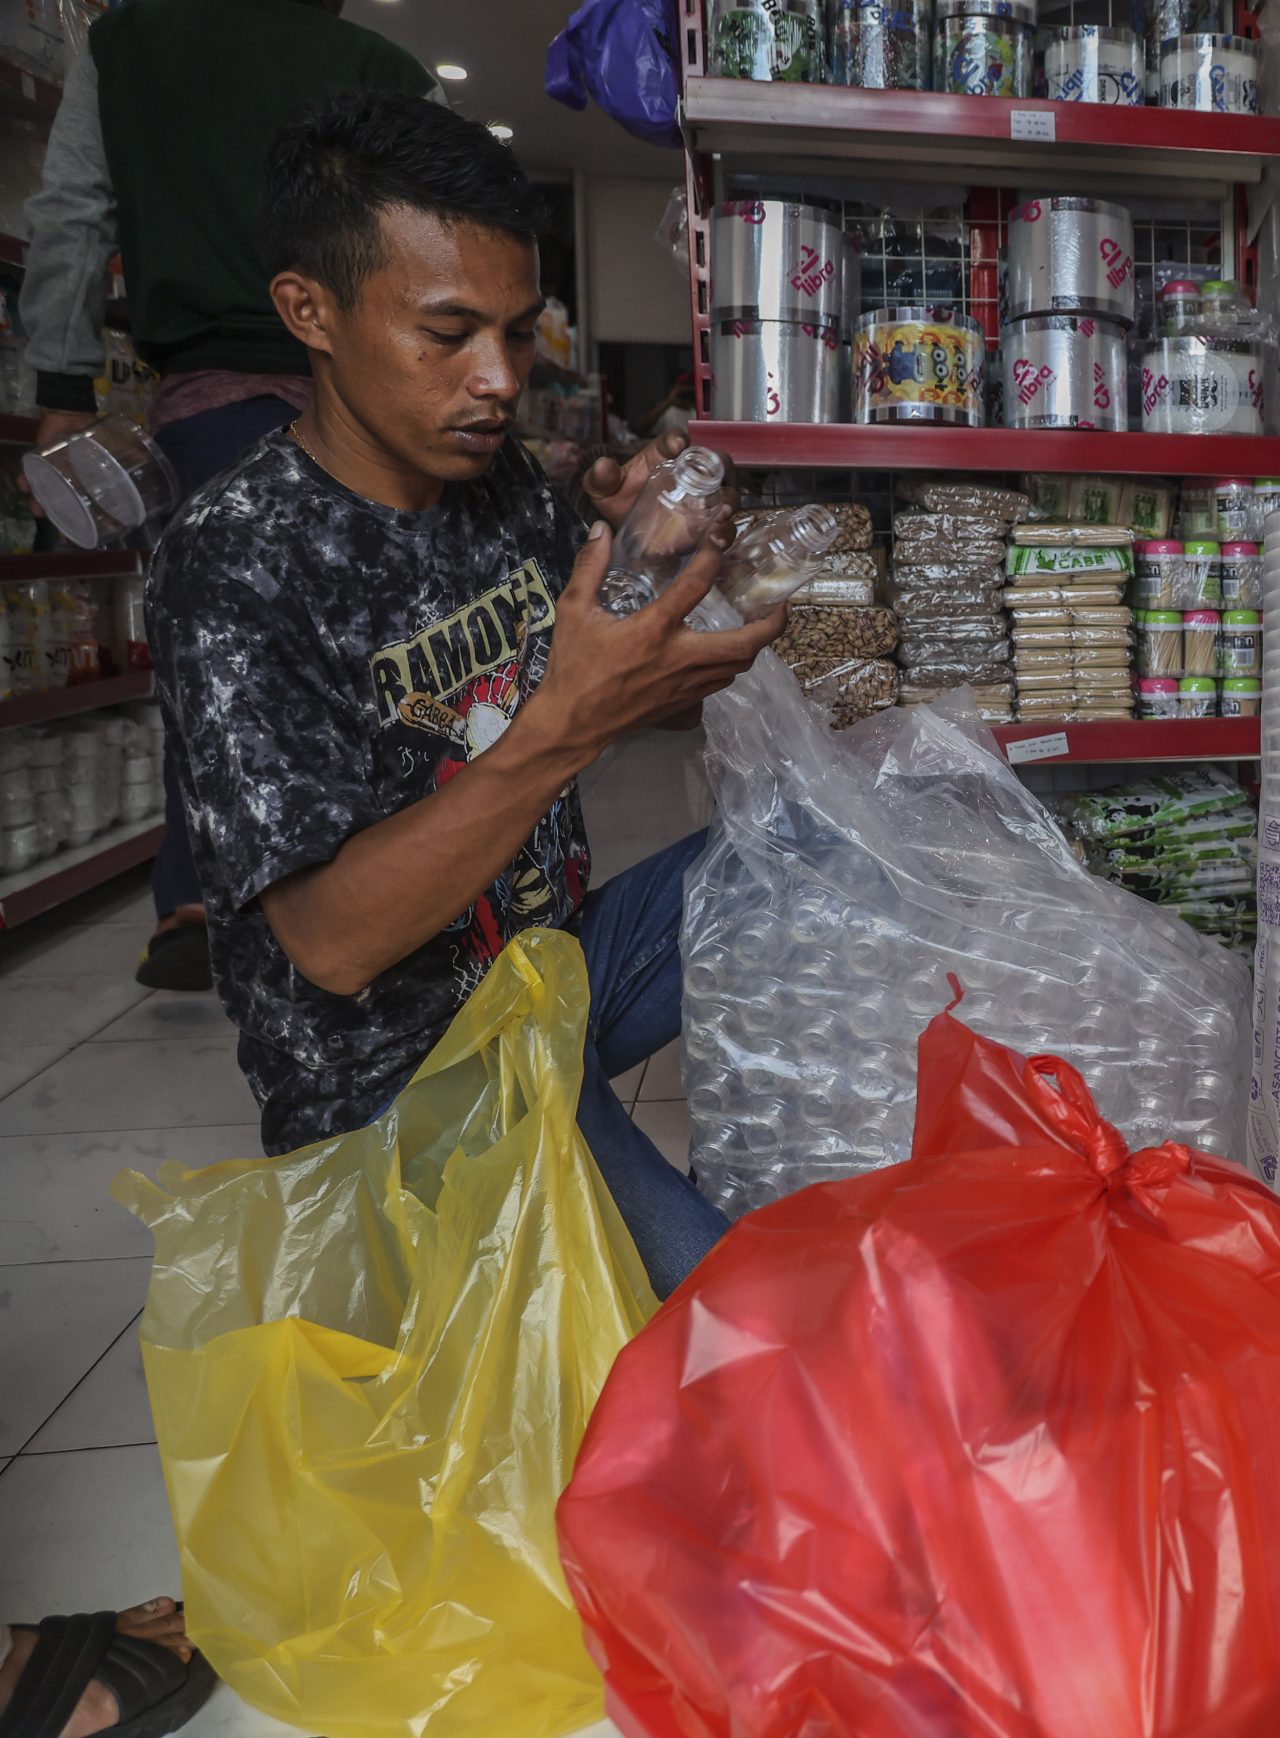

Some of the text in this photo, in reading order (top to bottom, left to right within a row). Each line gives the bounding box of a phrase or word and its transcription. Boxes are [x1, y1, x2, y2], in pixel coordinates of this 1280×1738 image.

[801, 259, 835, 298] libra
[1018, 364, 1054, 406] libra
[1059, 554, 1105, 569] CABE
